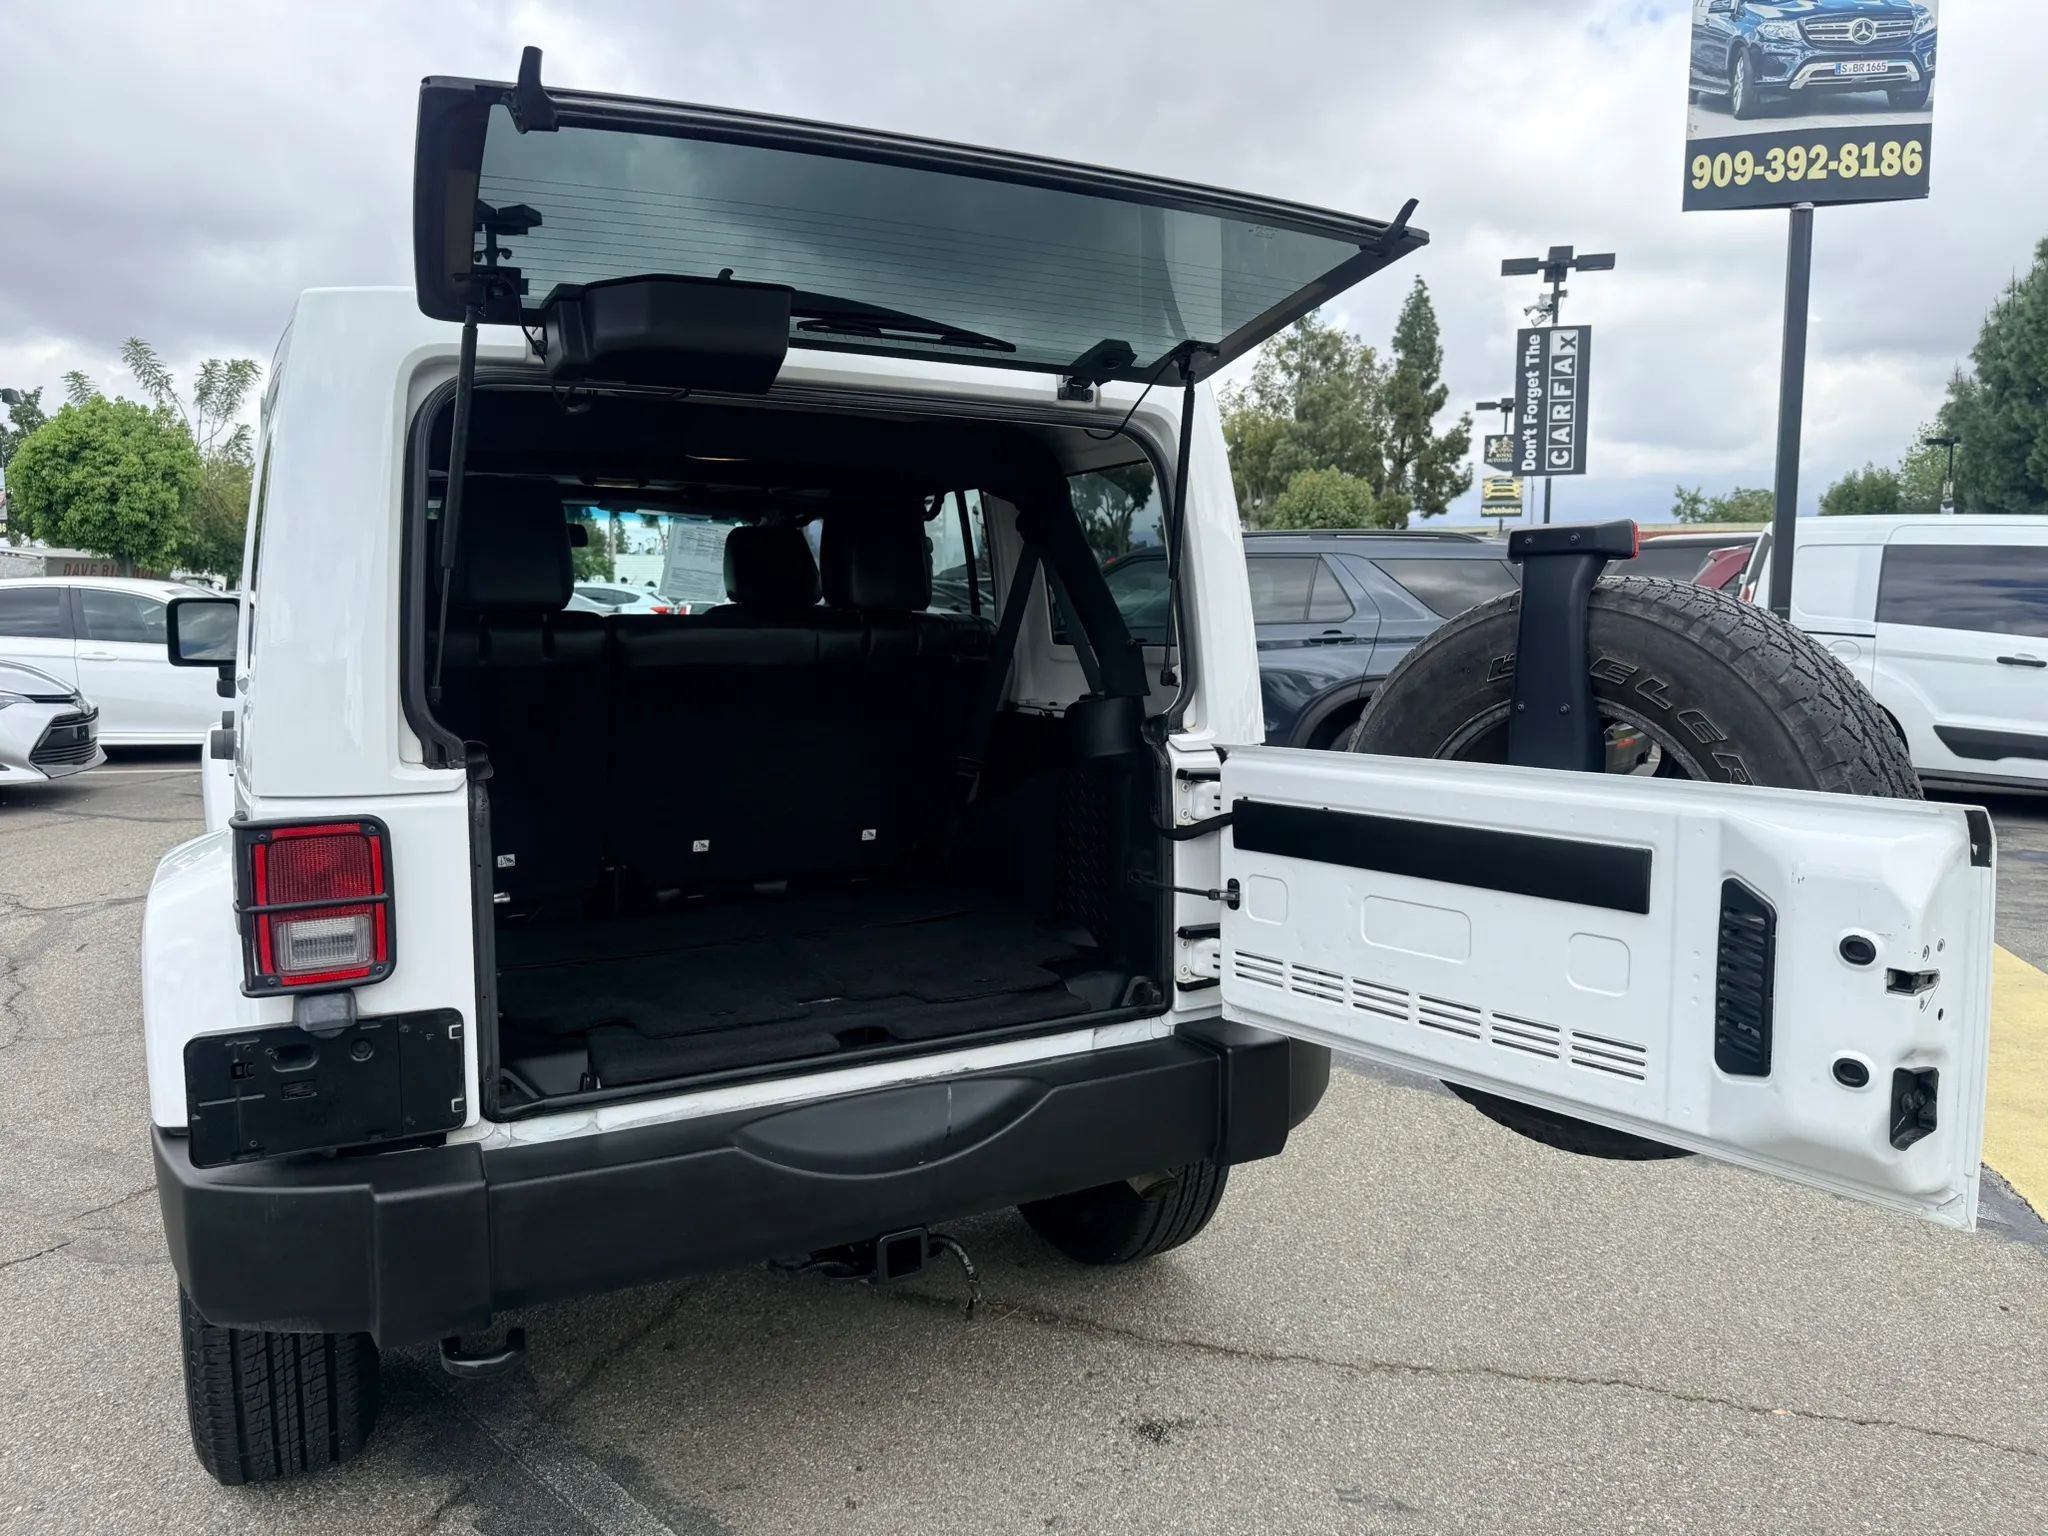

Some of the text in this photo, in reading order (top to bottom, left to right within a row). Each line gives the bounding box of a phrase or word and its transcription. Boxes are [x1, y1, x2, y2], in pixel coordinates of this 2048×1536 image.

[1691, 140, 1923, 190] 909-392-8186
[1521, 334, 1543, 471] Don't Forget The
[1551, 335, 1577, 466] CARFAX
[64, 562, 98, 577] DAVE
